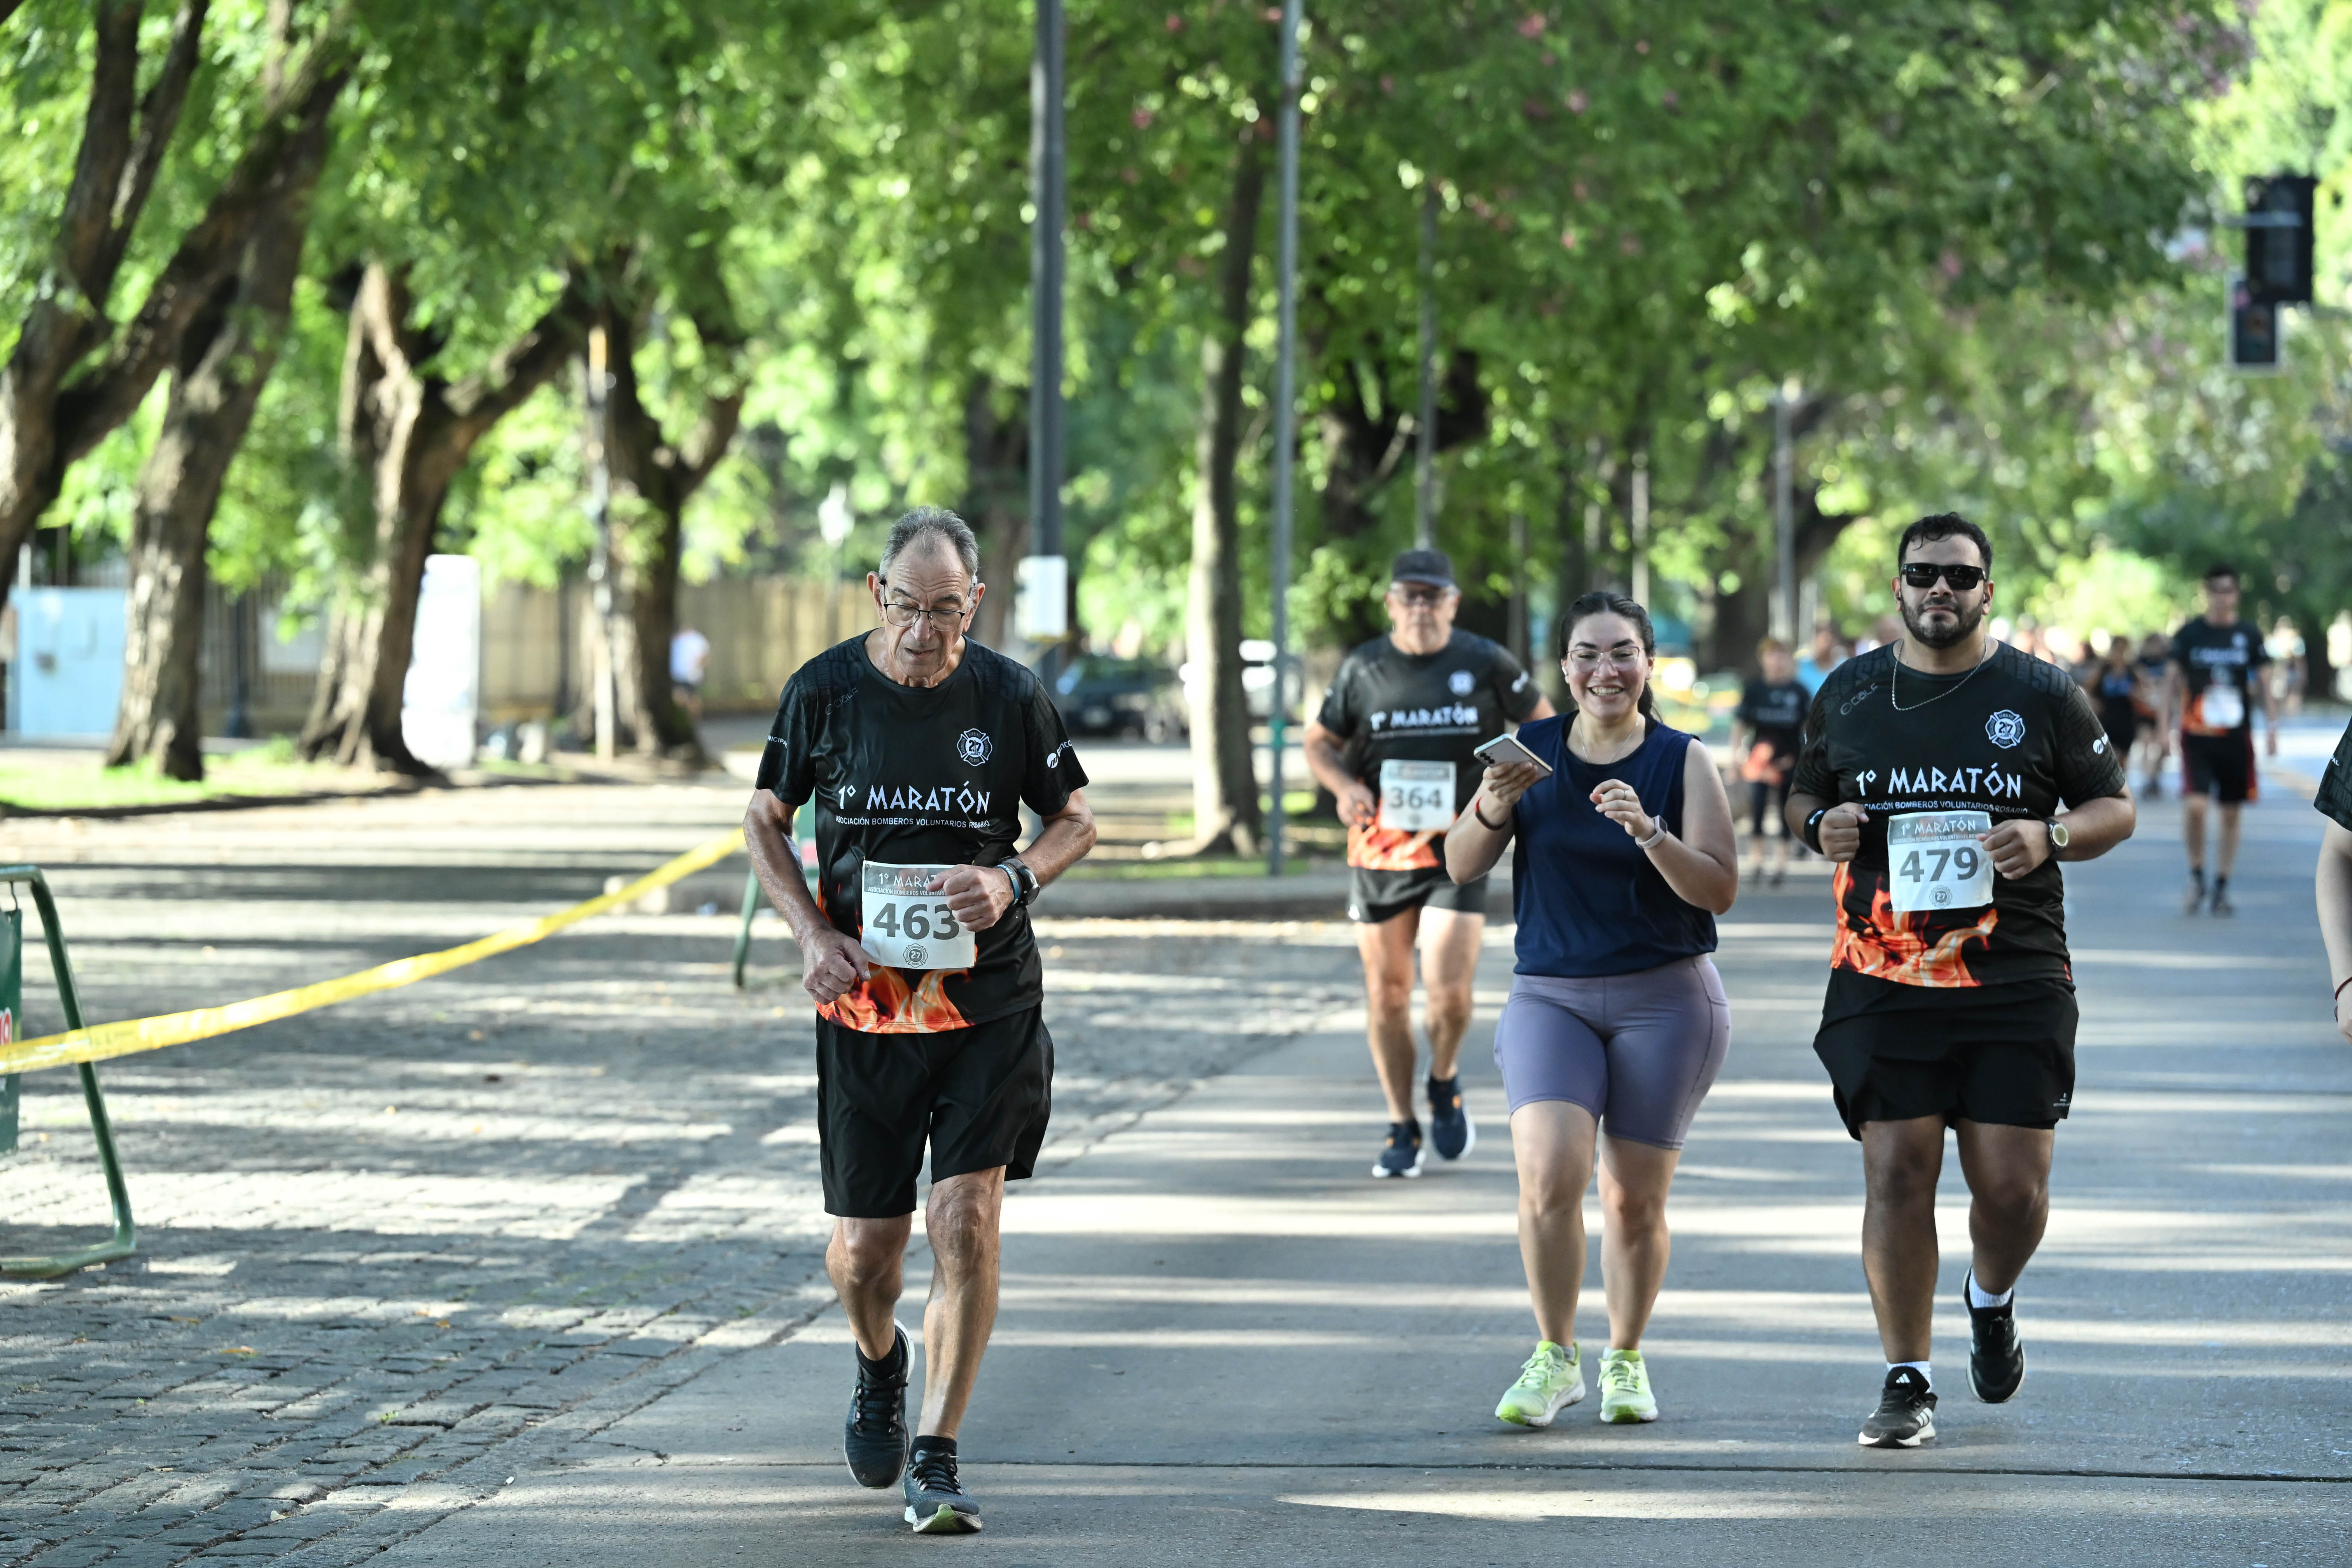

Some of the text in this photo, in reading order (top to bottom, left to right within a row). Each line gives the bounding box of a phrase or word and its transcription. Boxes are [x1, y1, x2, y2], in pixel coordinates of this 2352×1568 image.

[1998, 722, 2013, 733] 27
[768, 734, 787, 748] NICIPA
[969, 739, 982, 752] 27
[1888, 762, 2021, 799] MARATÓN
[866, 780, 990, 814] MARATÓN
[1388, 786, 1442, 809] 364
[1864, 800, 2028, 814] CIACIÓN BOMBEROS VOLUNTARIOS ROSARIO
[836, 815, 870, 826] ASOCIACIÓN
[916, 818, 967, 828] VOLUNTARIOS
[968, 820, 990, 829] ROSARIO
[1914, 817, 1976, 835] MARATÓN
[1899, 846, 1978, 882] 479
[893, 874, 937, 887] MARA
[868, 886, 893, 894] ASOCIACIÓN
[873, 903, 960, 940] 463
[911, 950, 921, 959] 27
